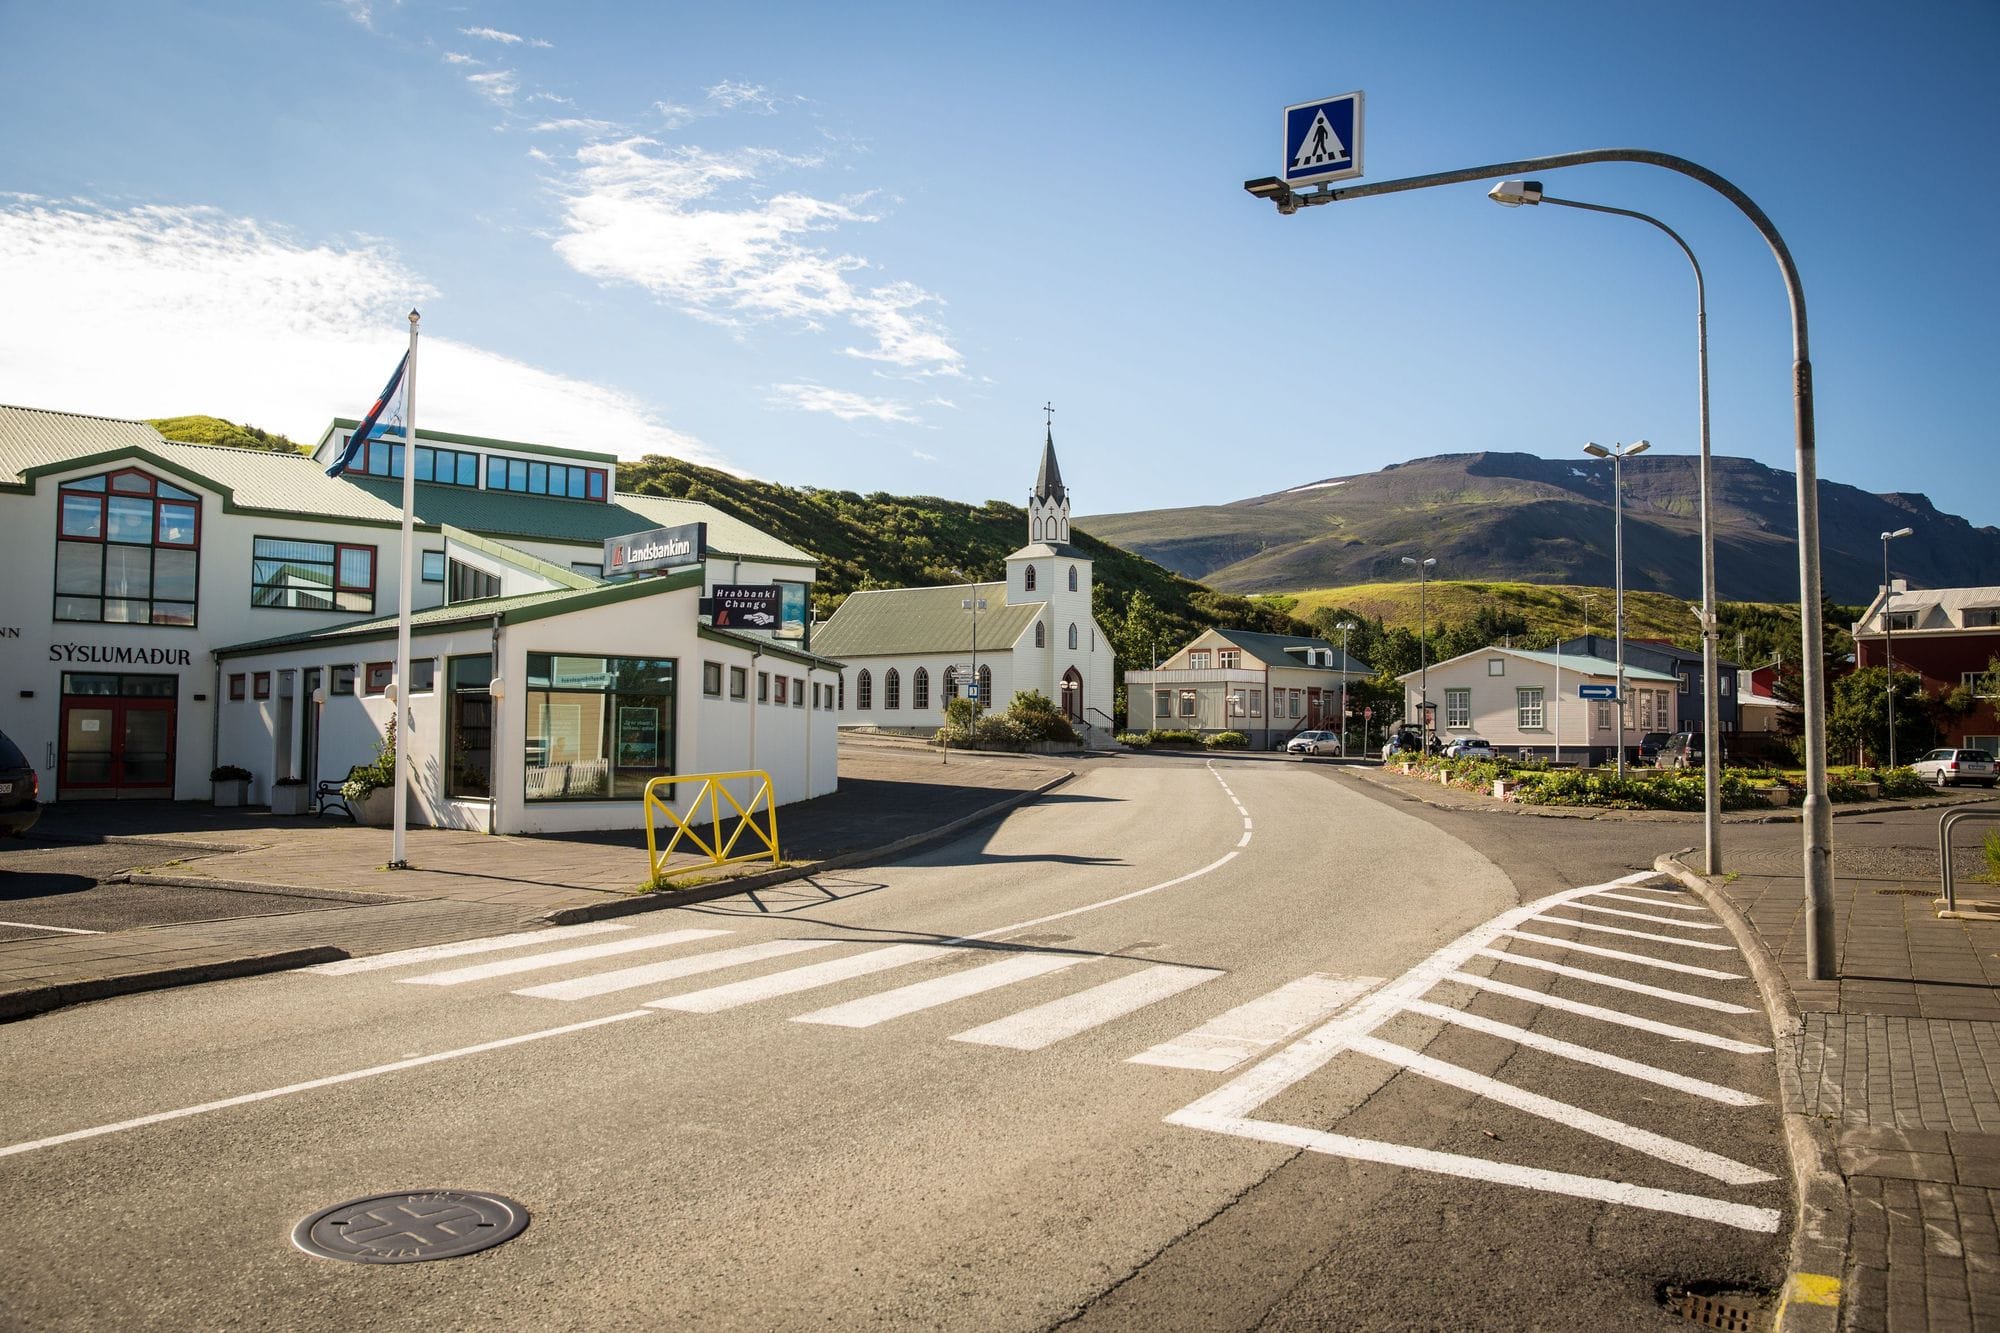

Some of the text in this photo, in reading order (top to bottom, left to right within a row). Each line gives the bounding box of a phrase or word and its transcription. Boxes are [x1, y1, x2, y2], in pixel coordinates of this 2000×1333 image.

[627, 538, 690, 563] Landsbankinn
[716, 589, 776, 598] Hraðbanki
[725, 600, 767, 610] Change
[50, 643, 191, 665] SÝSLUMAÐUR
